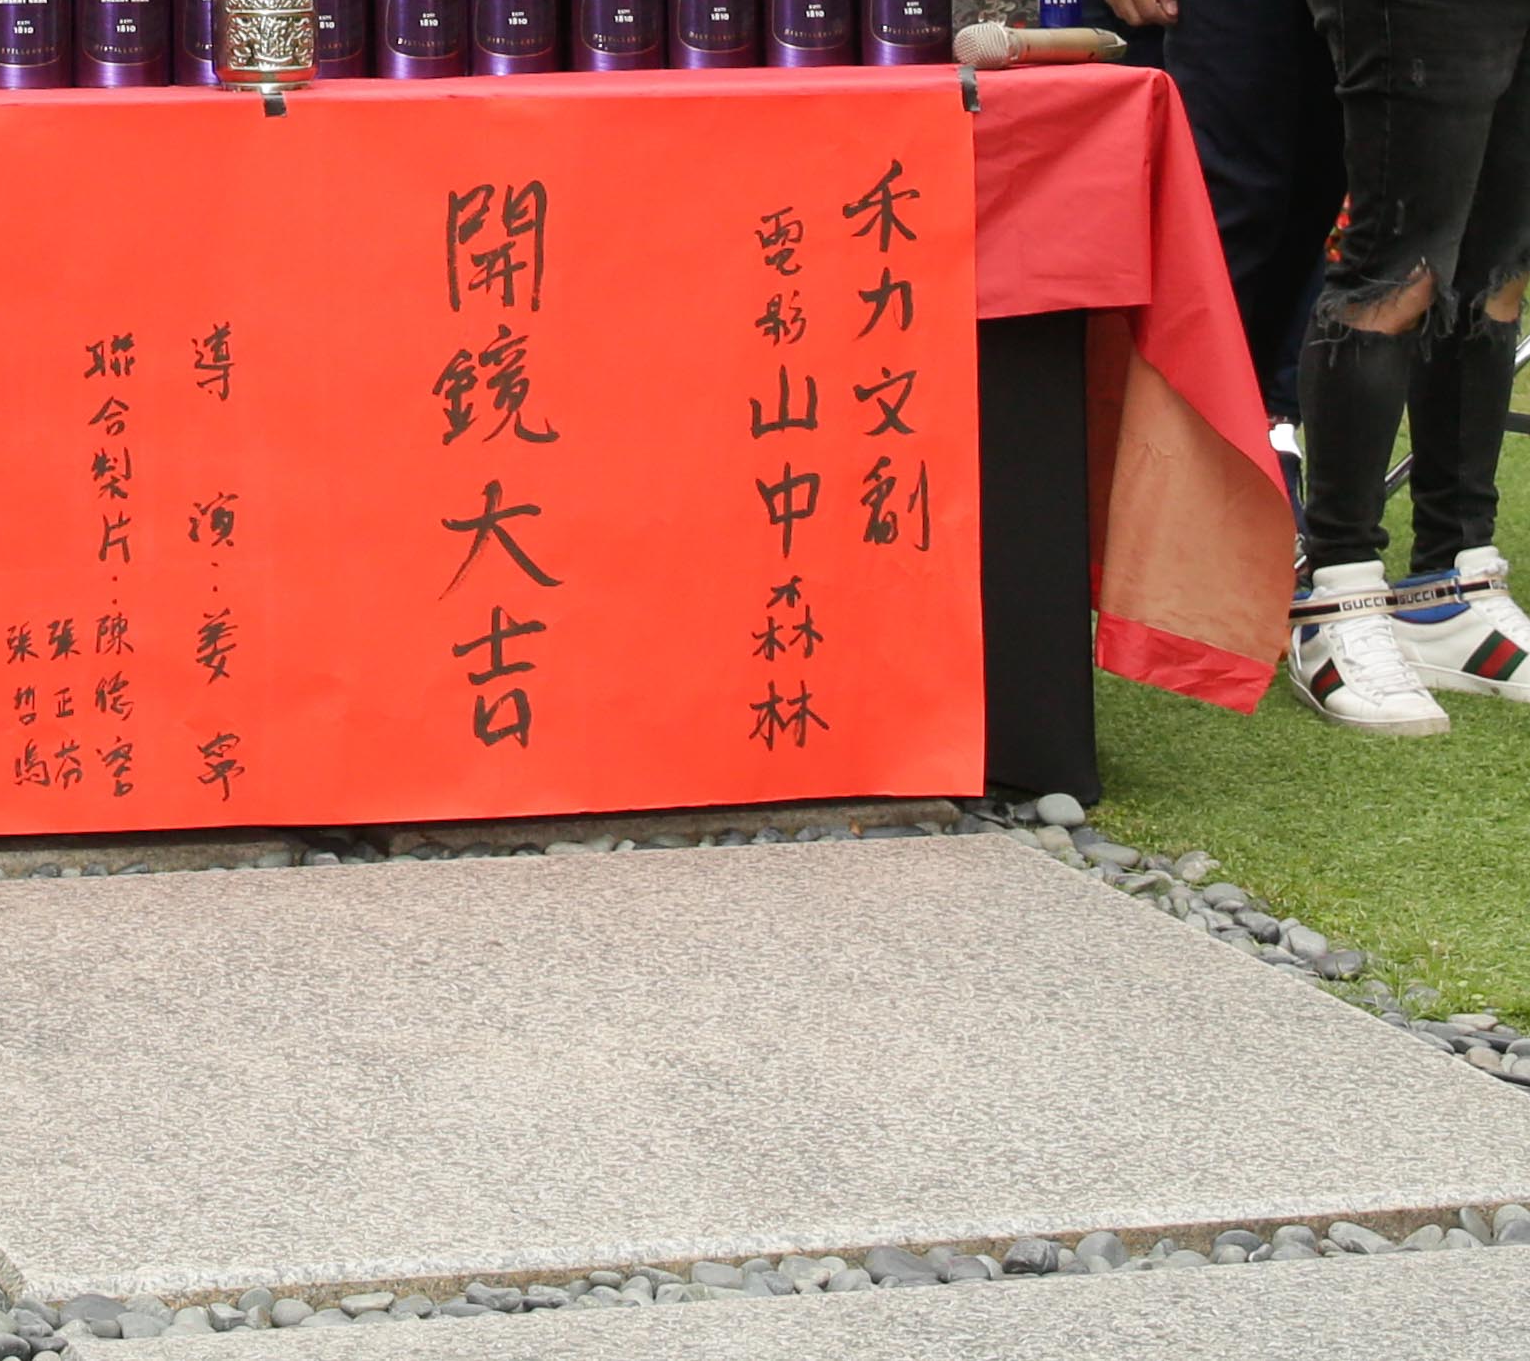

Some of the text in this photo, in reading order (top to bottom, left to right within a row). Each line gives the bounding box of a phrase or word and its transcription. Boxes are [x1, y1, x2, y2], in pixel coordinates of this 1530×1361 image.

[318, 21, 336, 30] 810
[842, 159, 931, 552] 禾力文創
[432, 179, 564, 748] 開鏡大吉
[1341, 596, 1387, 612] GUCCI
[1398, 590, 1437, 605] GUCCI
